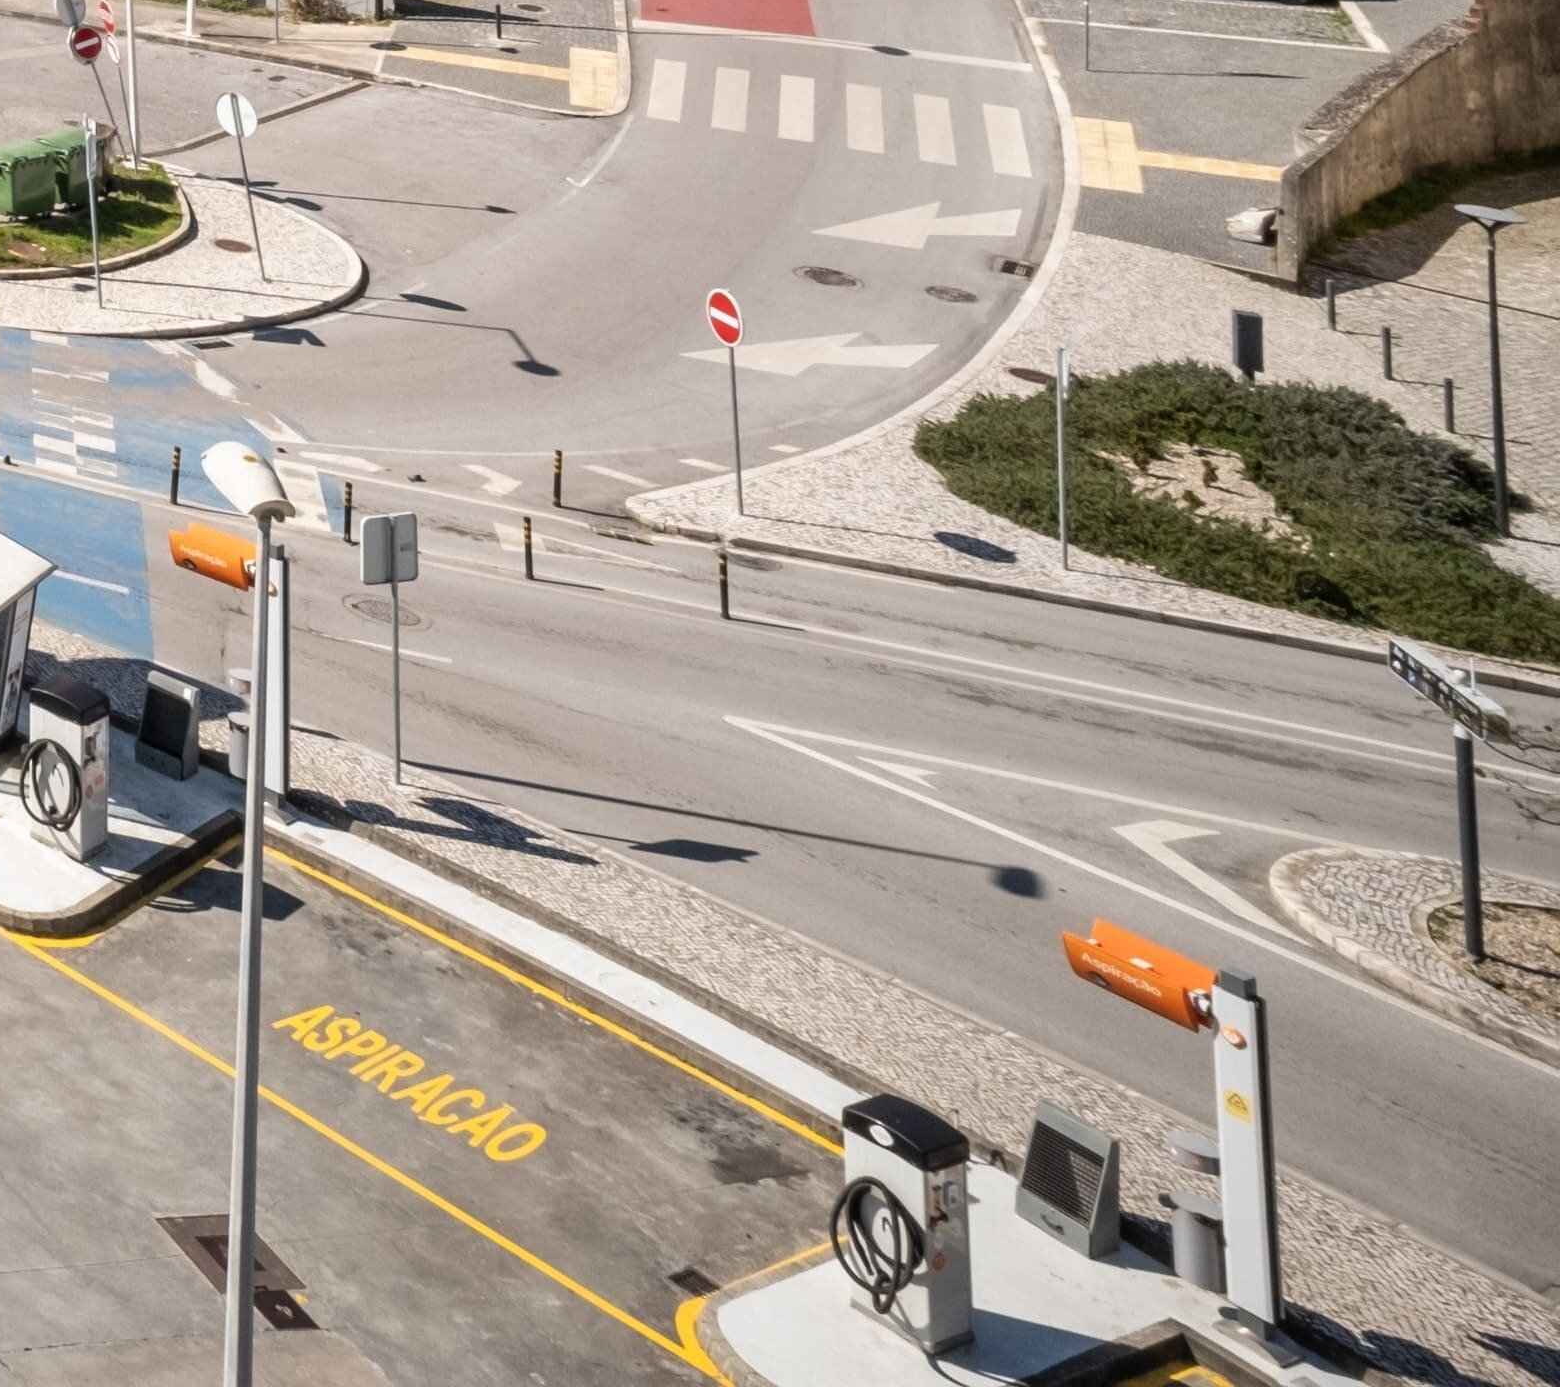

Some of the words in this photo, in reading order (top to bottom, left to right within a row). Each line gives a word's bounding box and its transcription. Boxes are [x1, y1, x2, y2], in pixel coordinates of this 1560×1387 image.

[178, 541, 229, 570] Aspiração
[1079, 949, 1164, 1000] Aspiração
[273, 1003, 548, 1164] ASPIRAÇÃO
